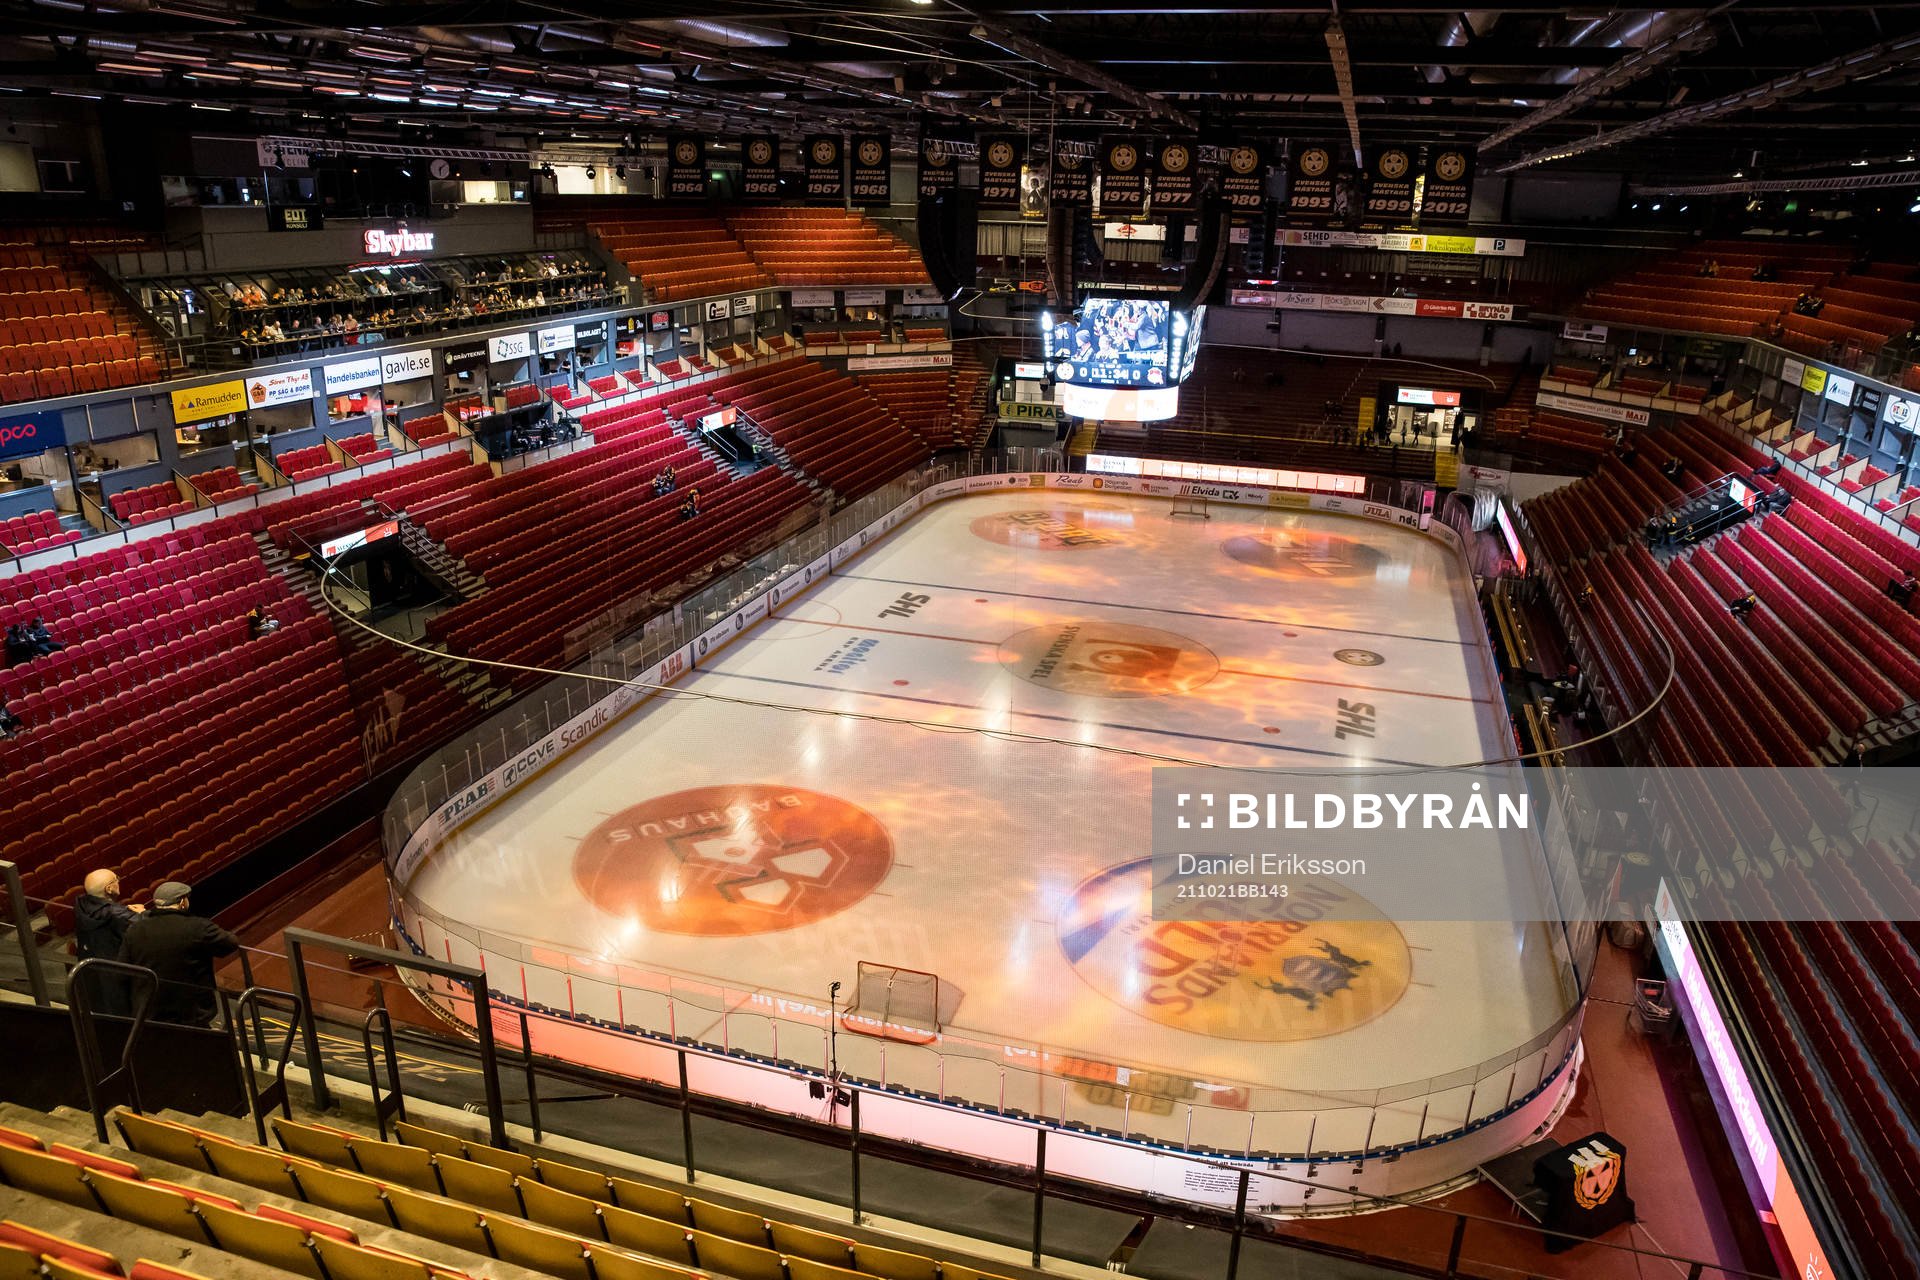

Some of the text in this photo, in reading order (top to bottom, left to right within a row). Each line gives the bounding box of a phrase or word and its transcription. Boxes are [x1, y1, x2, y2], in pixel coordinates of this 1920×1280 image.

[672, 183, 703, 193] 1964
[745, 183, 777, 193] 1966
[807, 183, 841, 193] 1967
[853, 184, 888, 195] 1968
[921, 186, 937, 196] 19
[983, 187, 1015, 198] 1971
[1052, 189, 1087, 200] 1972
[1103, 191, 1141, 202] 1976
[1154, 192, 1192, 203] 1977
[1291, 196, 1331, 208] 1993
[1368, 199, 1410, 211] 1999
[1424, 202, 1468, 214] 2012
[1303, 231, 1329, 240] SEHED
[365, 229, 434, 256] Skybar
[1479, 305, 1510, 314] BRYNÄS
[508, 342, 523, 355] SSG
[386, 356, 430, 379] gavle.se
[1080, 367, 1088, 377] 0
[1133, 370, 1140, 380] 0
[327, 368, 380, 385] Handelsbanken
[295, 384, 310, 394] BORR
[196, 392, 241, 408] Ramudden
[1191, 485, 1220, 497] Elvida
[1364, 506, 1390, 519] JULA
[1399, 513, 1417, 527] nds
[877, 592, 930, 618] SHL
[1030, 625, 1080, 679] SVENSKA SPEL
[660, 652, 683, 684] ABB
[1335, 698, 1376, 740] SHL
[561, 706, 609, 749] Scandic
[517, 739, 555, 772] CCVE
[443, 782, 488, 822] PEAB
[608, 795, 802, 843] BAHAUS
